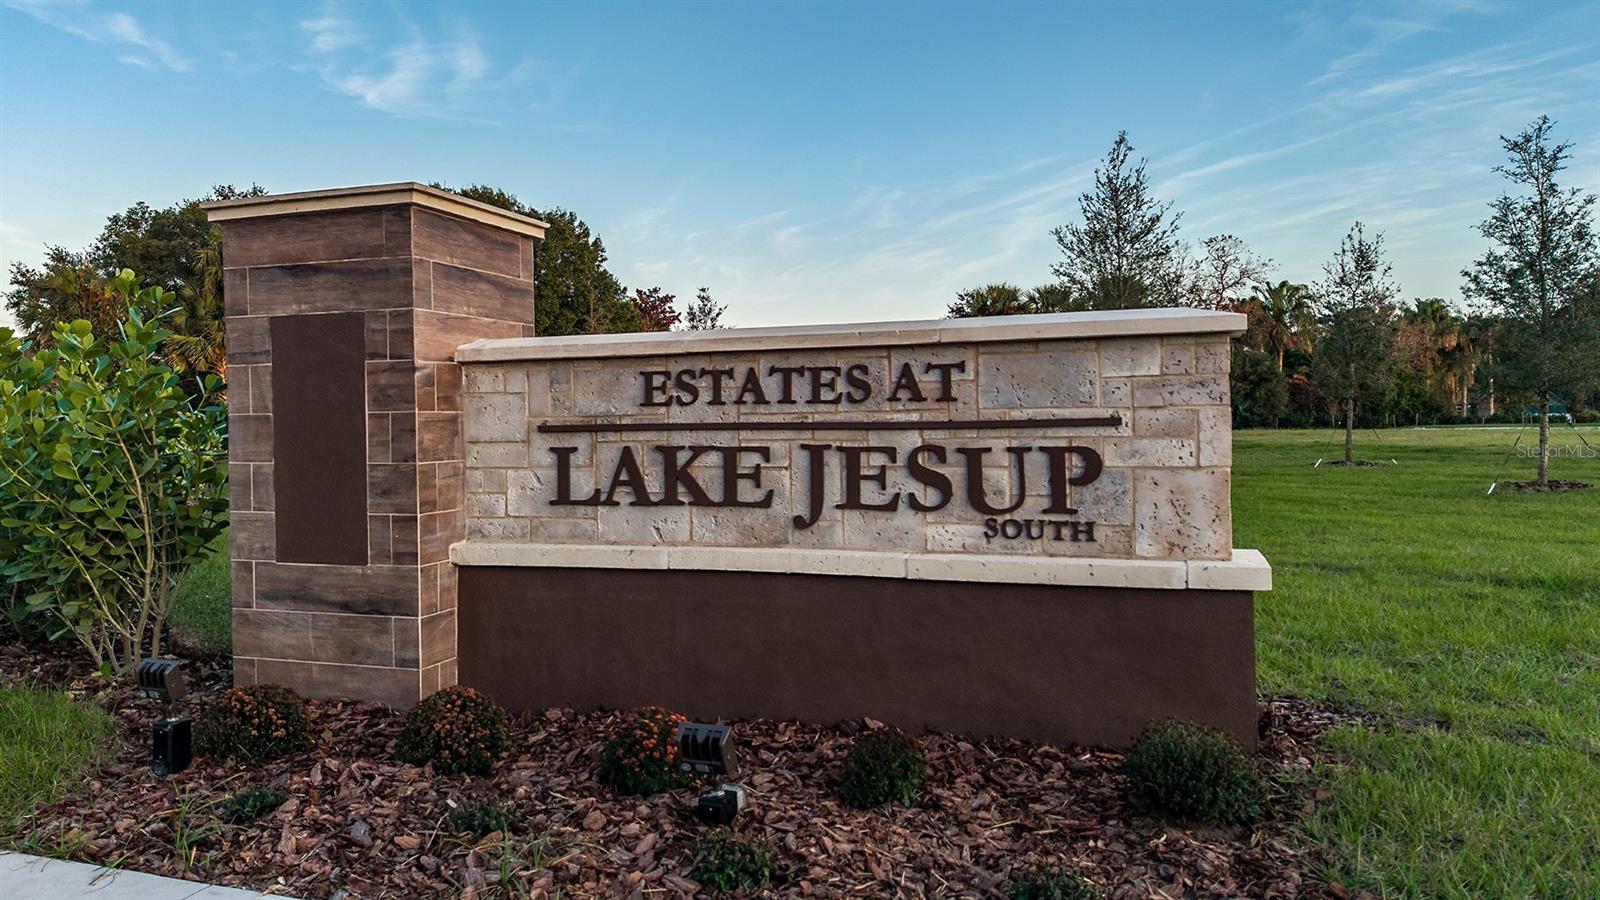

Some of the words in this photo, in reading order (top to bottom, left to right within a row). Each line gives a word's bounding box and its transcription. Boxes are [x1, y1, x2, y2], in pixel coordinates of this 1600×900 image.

[640, 366, 870, 406] ESTATES
[887, 360, 965, 401] AT
[549, 446, 774, 507] LAKE
[794, 443, 1103, 529] JESUP
[983, 517, 1096, 543] SOUTH
